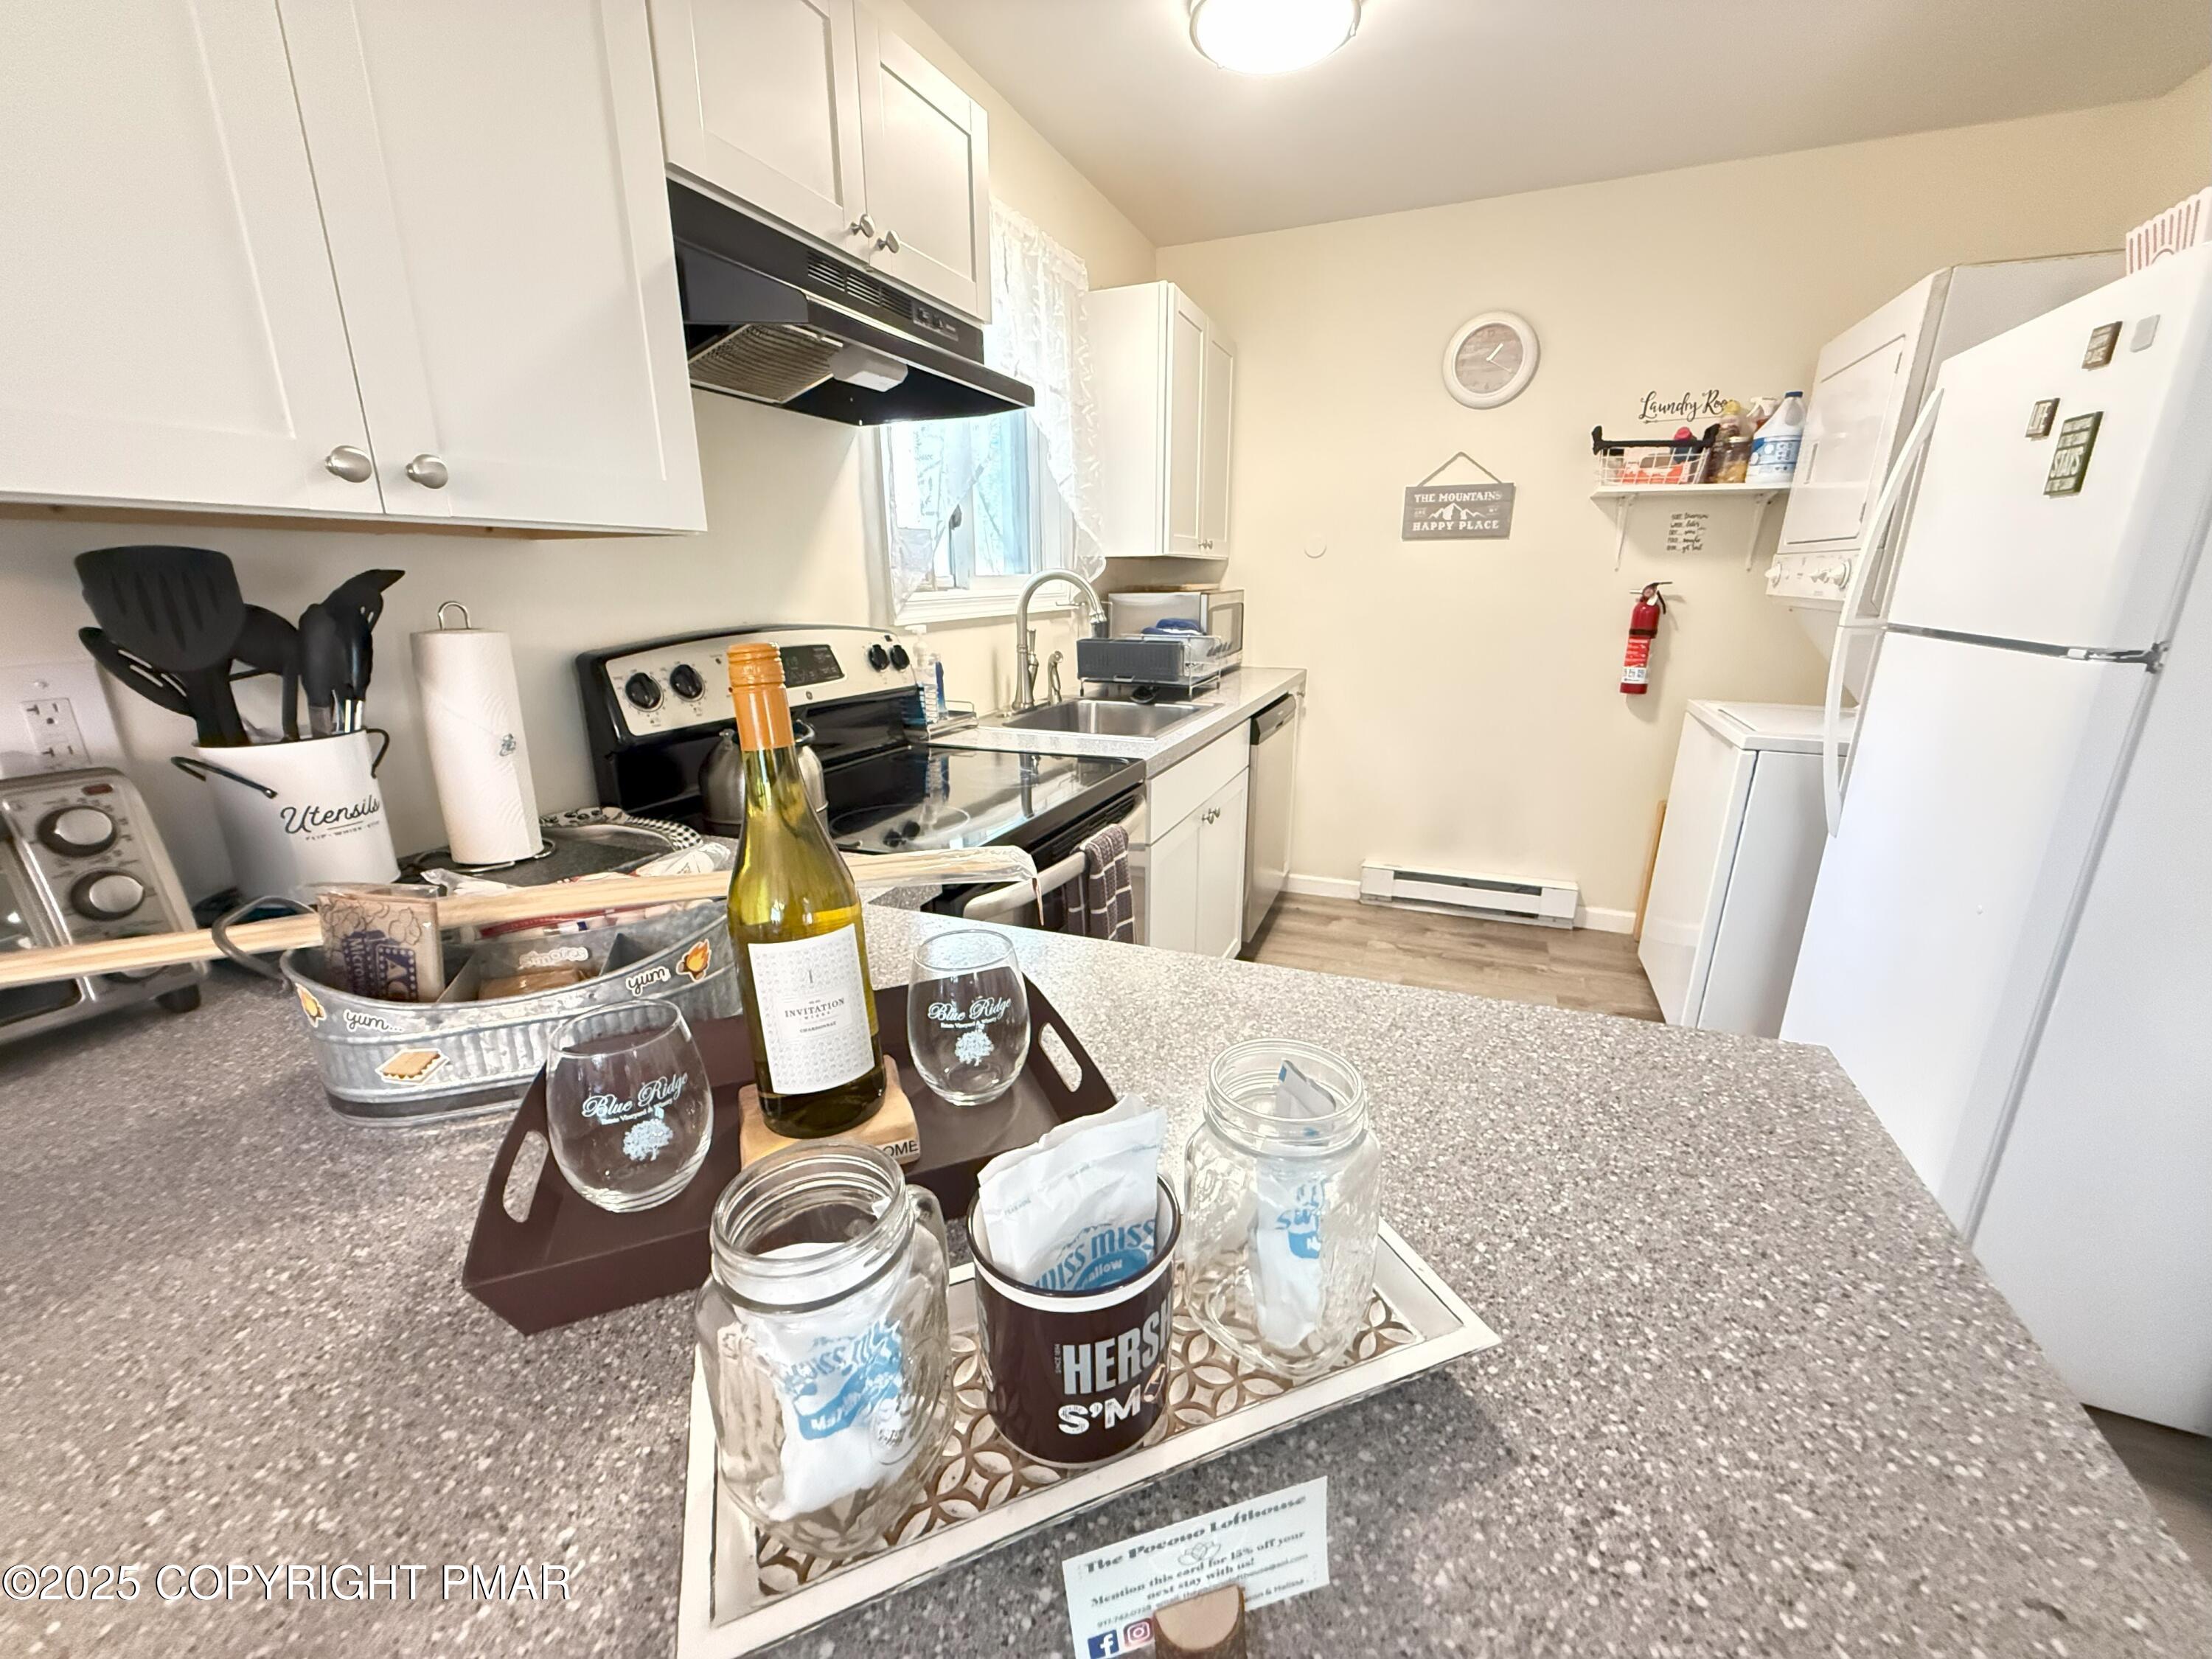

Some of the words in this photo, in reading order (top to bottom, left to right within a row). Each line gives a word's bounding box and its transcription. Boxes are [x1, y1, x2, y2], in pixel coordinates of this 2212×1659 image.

[1638, 391, 1703, 422] Laundry
[1702, 389, 1728, 415] Roo
[1414, 493, 1436, 503] THE
[1439, 491, 1503, 502] MOUNTAINS
[1412, 521, 1454, 531] HAPPY
[1458, 520, 1500, 530] PLACE
[280, 794, 380, 834] Utensils
[627, 967, 667, 995] yum
[785, 998, 845, 1018] INVITATION
[927, 1001, 966, 1021] Blue
[968, 996, 1012, 1020] Ridge
[581, 1093, 633, 1118] Blue
[637, 1072, 689, 1107] Ridge
[1085, 1555, 1124, 1573] The
[1128, 1528, 1206, 1559] Pocono
[1210, 1496, 1307, 1532] Lofthouse
[1091, 1584, 1145, 1607] Mention
[1149, 1573, 1174, 1587] this
[1176, 1562, 1205, 1578] card
[1208, 1556, 1227, 1568] for
[1256, 1537, 1276, 1551] off
[1277, 1531, 1305, 1547] your
[1147, 1585, 1174, 1600] next
[1178, 1576, 1202, 1590] stay
[1206, 1565, 1234, 1580] with
[1237, 1557, 1255, 1571] us!
